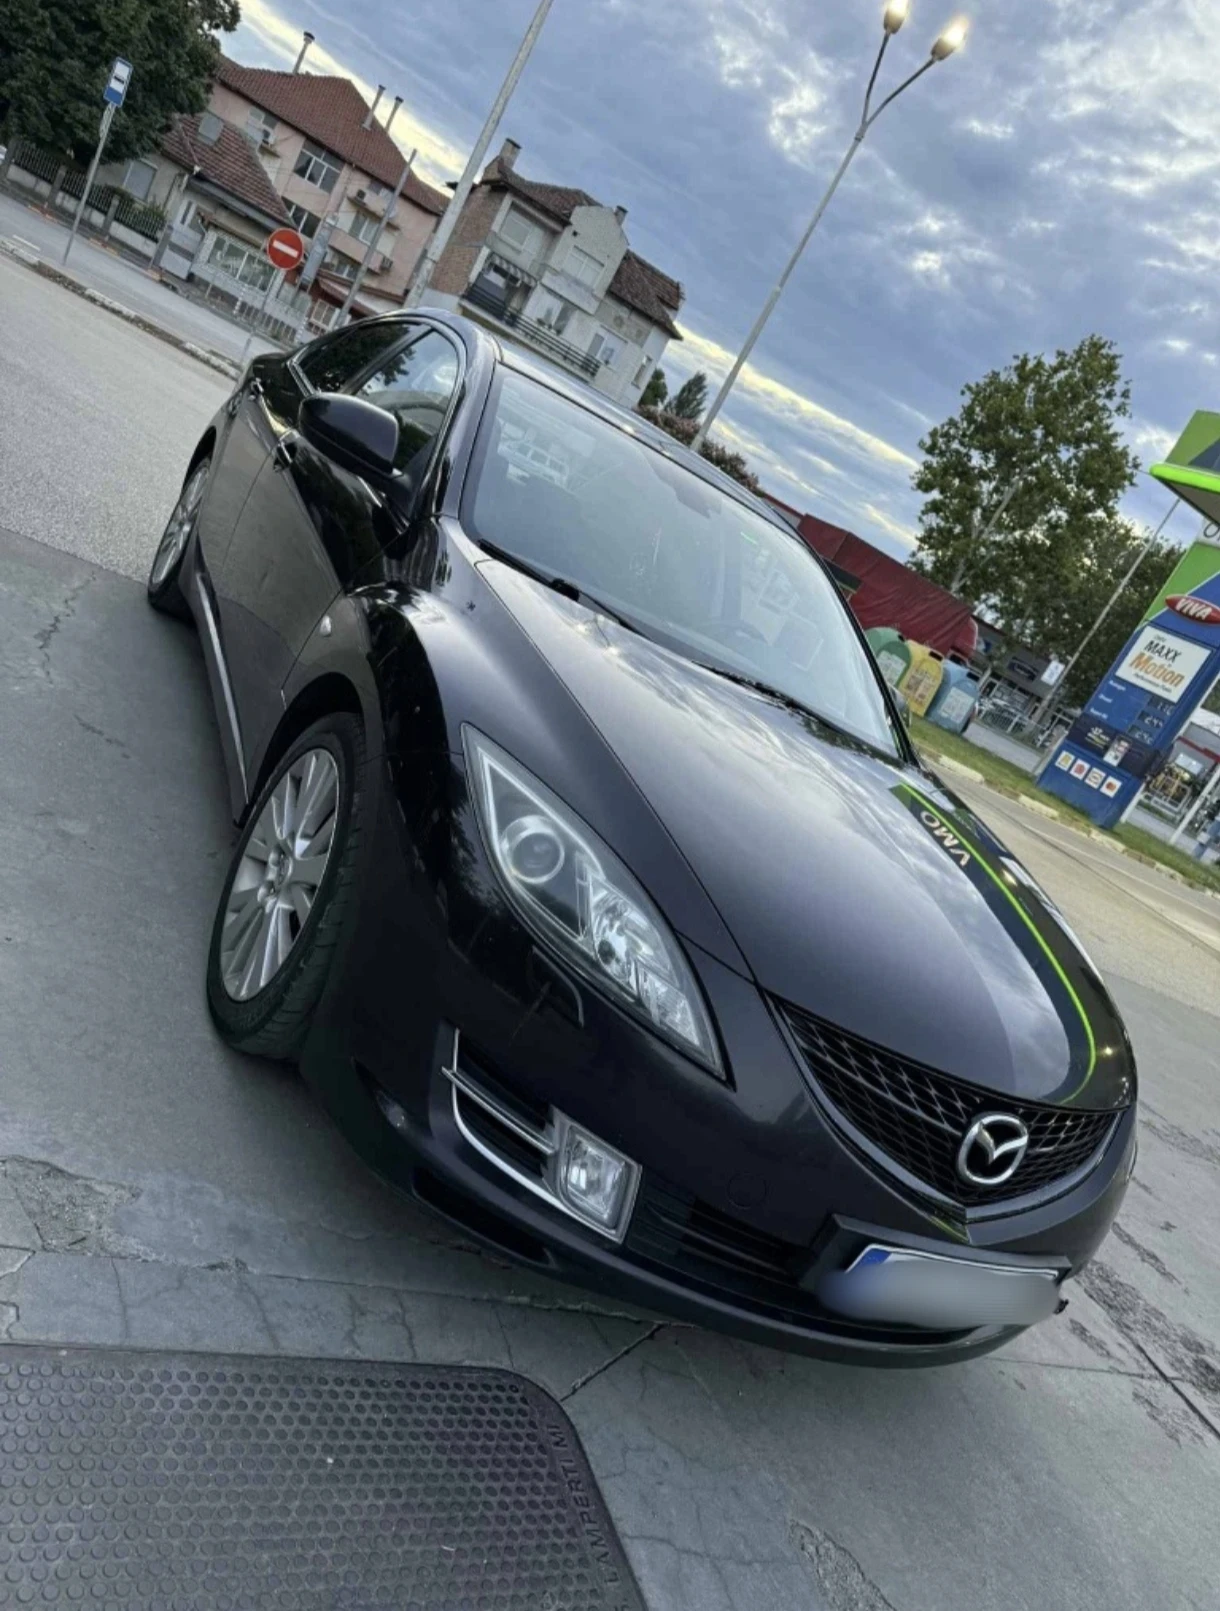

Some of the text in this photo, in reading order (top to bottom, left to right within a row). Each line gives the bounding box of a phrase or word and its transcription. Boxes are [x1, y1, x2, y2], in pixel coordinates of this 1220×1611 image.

[1175, 598, 1213, 620] VIVA
[1144, 640, 1182, 663] MAXX
[1129, 651, 1185, 688] Motion
[559, 1458, 619, 1584] LAMPERTI
